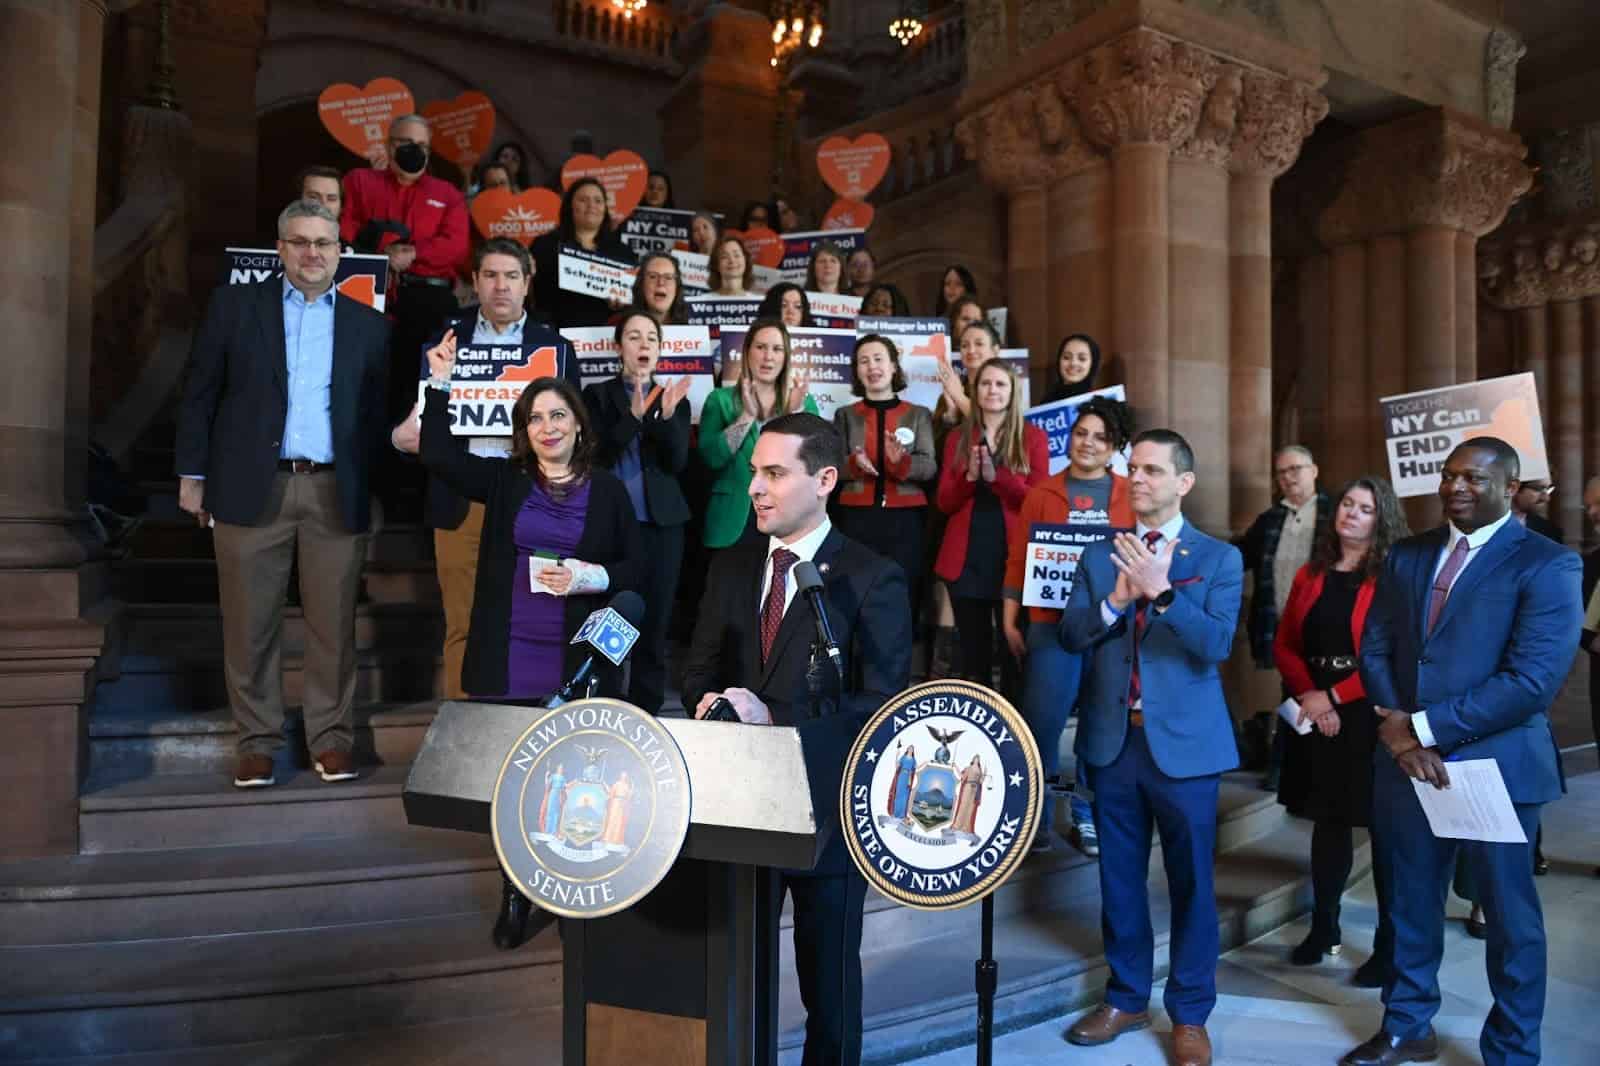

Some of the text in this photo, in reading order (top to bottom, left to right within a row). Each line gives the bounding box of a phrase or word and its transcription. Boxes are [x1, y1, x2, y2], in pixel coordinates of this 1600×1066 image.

[489, 221, 557, 233] FOOD BANK
[627, 221, 688, 238] NY Can
[230, 268, 272, 285] NY
[563, 266, 607, 284] School
[586, 281, 604, 292] for
[692, 303, 760, 316] We suppor
[811, 302, 839, 314] ding
[859, 320, 878, 331] End
[880, 321, 915, 333] Hunger
[573, 338, 622, 352] Endin
[659, 340, 703, 354] nger
[790, 337, 823, 350] port
[457, 348, 522, 360] Can End
[810, 353, 851, 365] meals
[450, 364, 493, 378] nger:
[580, 361, 623, 373] tarts
[656, 360, 704, 372] chool.
[809, 368, 844, 380] kids.
[451, 387, 521, 401] ncreas
[447, 404, 510, 428] SNA
[1392, 407, 1480, 435] NY Can
[1048, 434, 1069, 454] ay
[1395, 435, 1452, 458] END
[1035, 531, 1051, 540] NY
[1052, 532, 1073, 541] Can
[1074, 533, 1095, 542] End
[1035, 547, 1079, 565] Expa
[1040, 585, 1055, 600] &
[608, 612, 635, 641] NEWS
[891, 696, 1014, 747] ASSEMBLY
[513, 708, 677, 792] NEW YORK STATE
[854, 784, 1021, 893] STATE OF NEW YORK
[528, 868, 616, 906] SENATE
